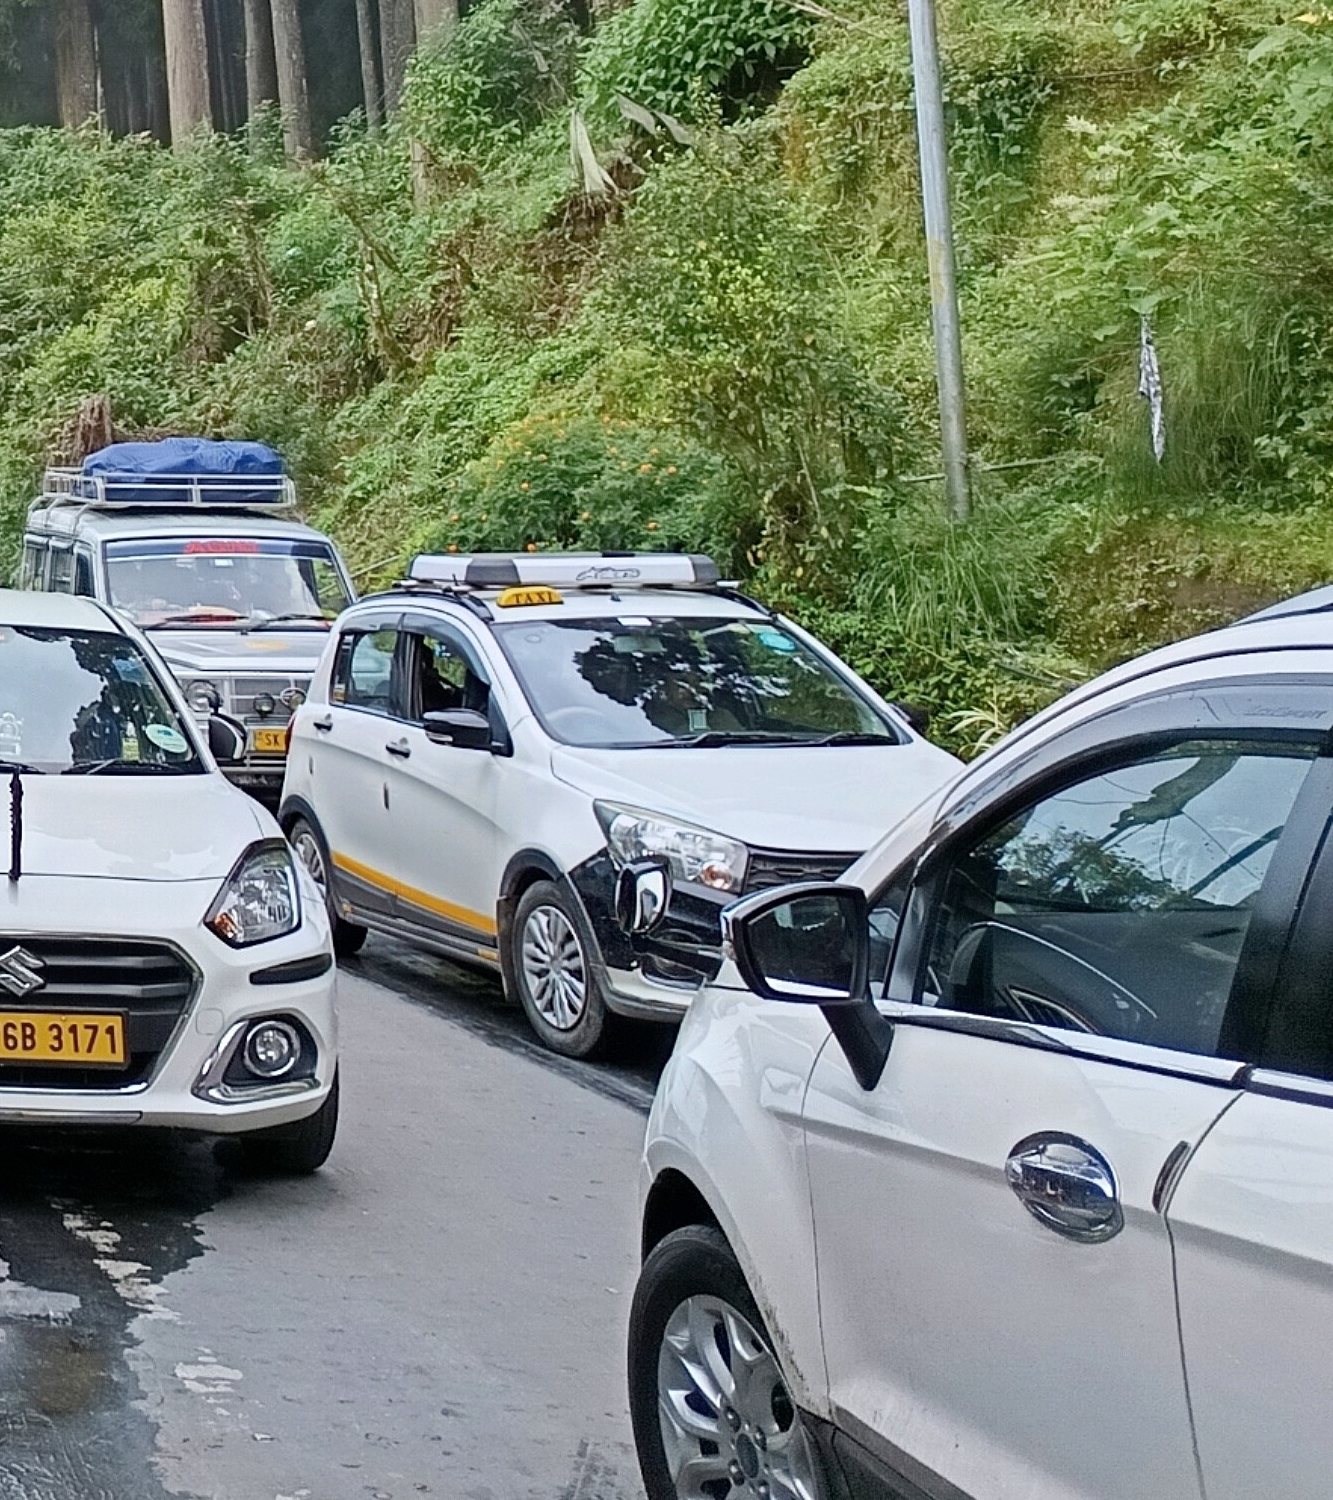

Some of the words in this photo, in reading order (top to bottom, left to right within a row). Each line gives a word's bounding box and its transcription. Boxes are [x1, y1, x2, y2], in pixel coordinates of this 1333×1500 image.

[513, 592, 553, 604] TAXI
[265, 733, 280, 746] SK
[48, 1023, 116, 1054] 3171
